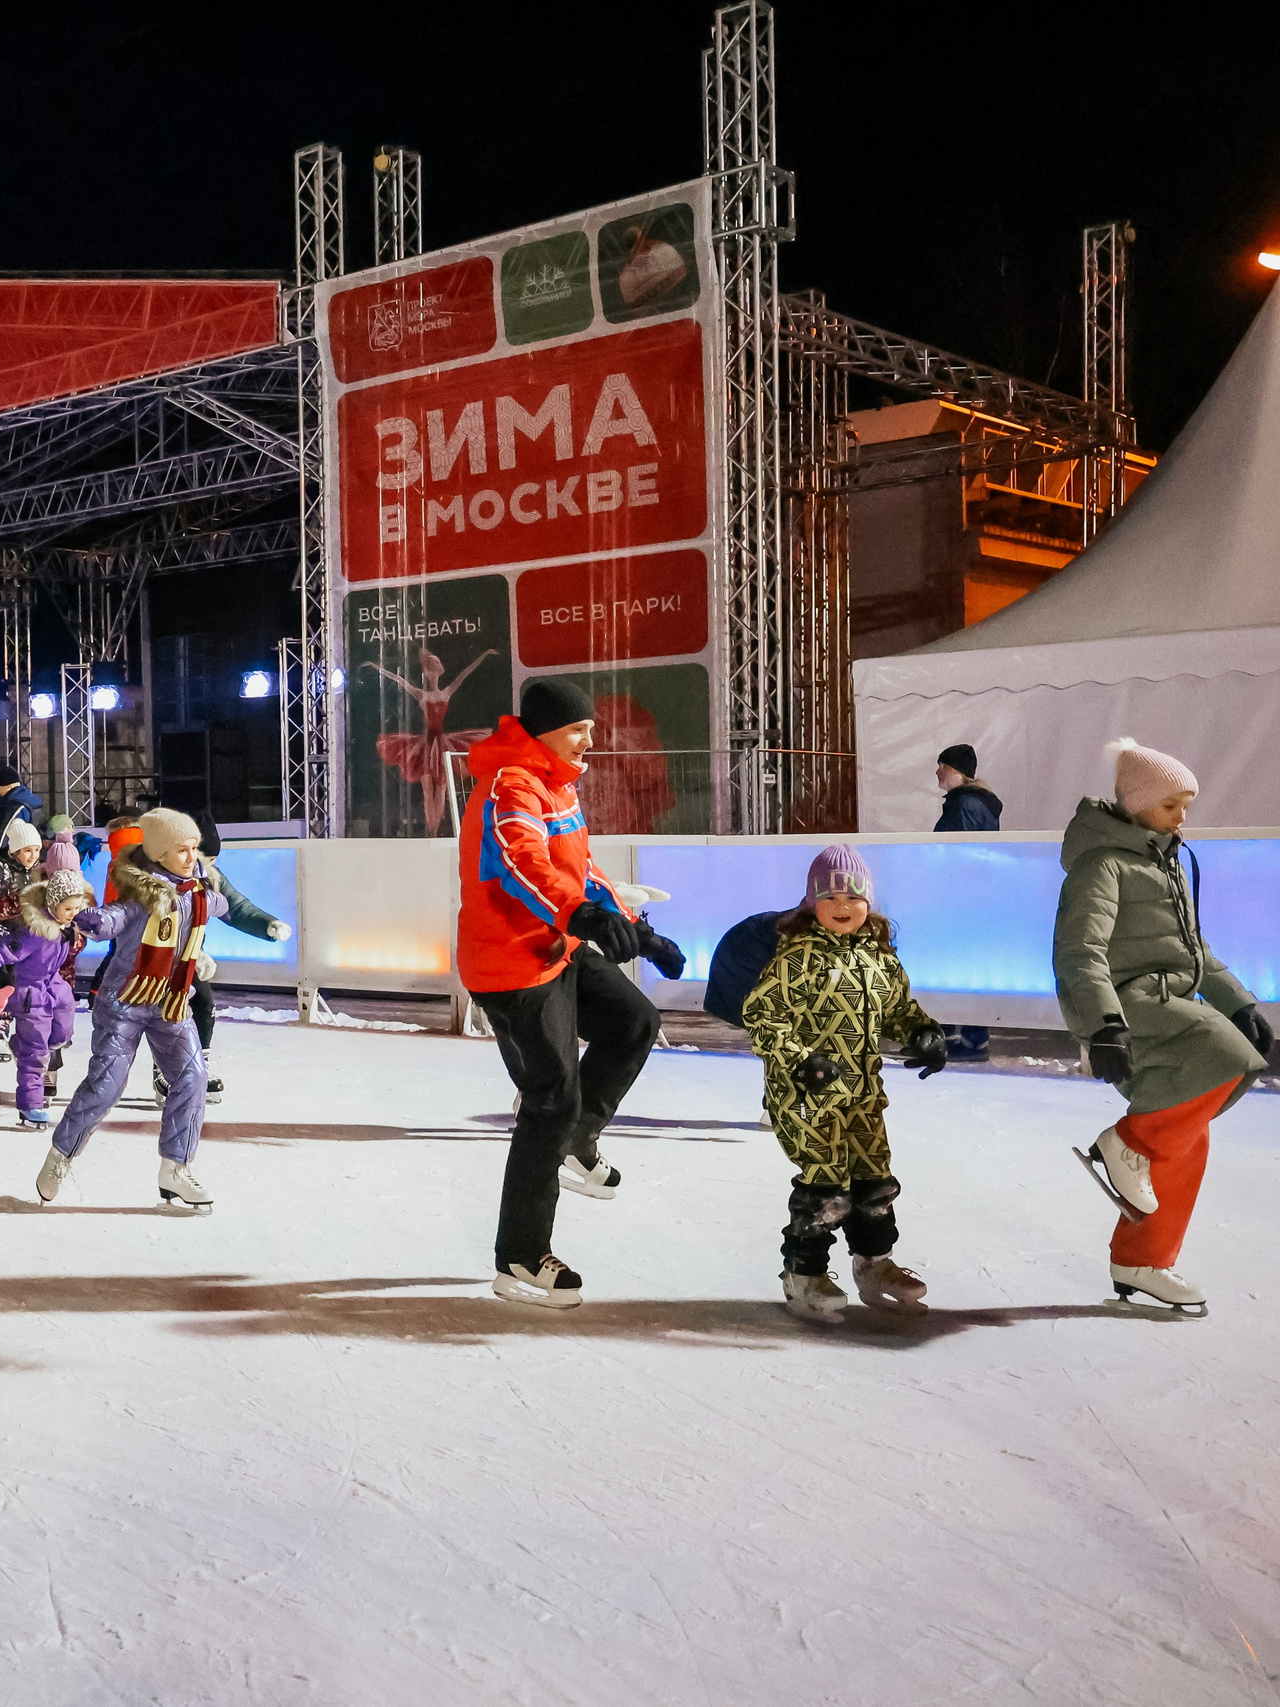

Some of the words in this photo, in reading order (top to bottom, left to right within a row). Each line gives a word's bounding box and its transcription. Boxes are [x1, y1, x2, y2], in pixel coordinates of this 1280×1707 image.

[406, 294, 444, 311] ПРОЕКТ
[407, 309, 435, 323] МЭРА
[407, 316, 452, 335] МОСКВЫ
[375, 373, 659, 490] ЗИМА
[380, 504, 407, 544] В
[427, 462, 660, 537] МОСКВЕ
[358, 604, 398, 622] ВСЕ
[540, 606, 584, 625] ВСЕ
[591, 603, 606, 620] В
[613, 594, 681, 618] ПАРК!
[358, 617, 481, 643] ТАНЦЕВАТЬ!
